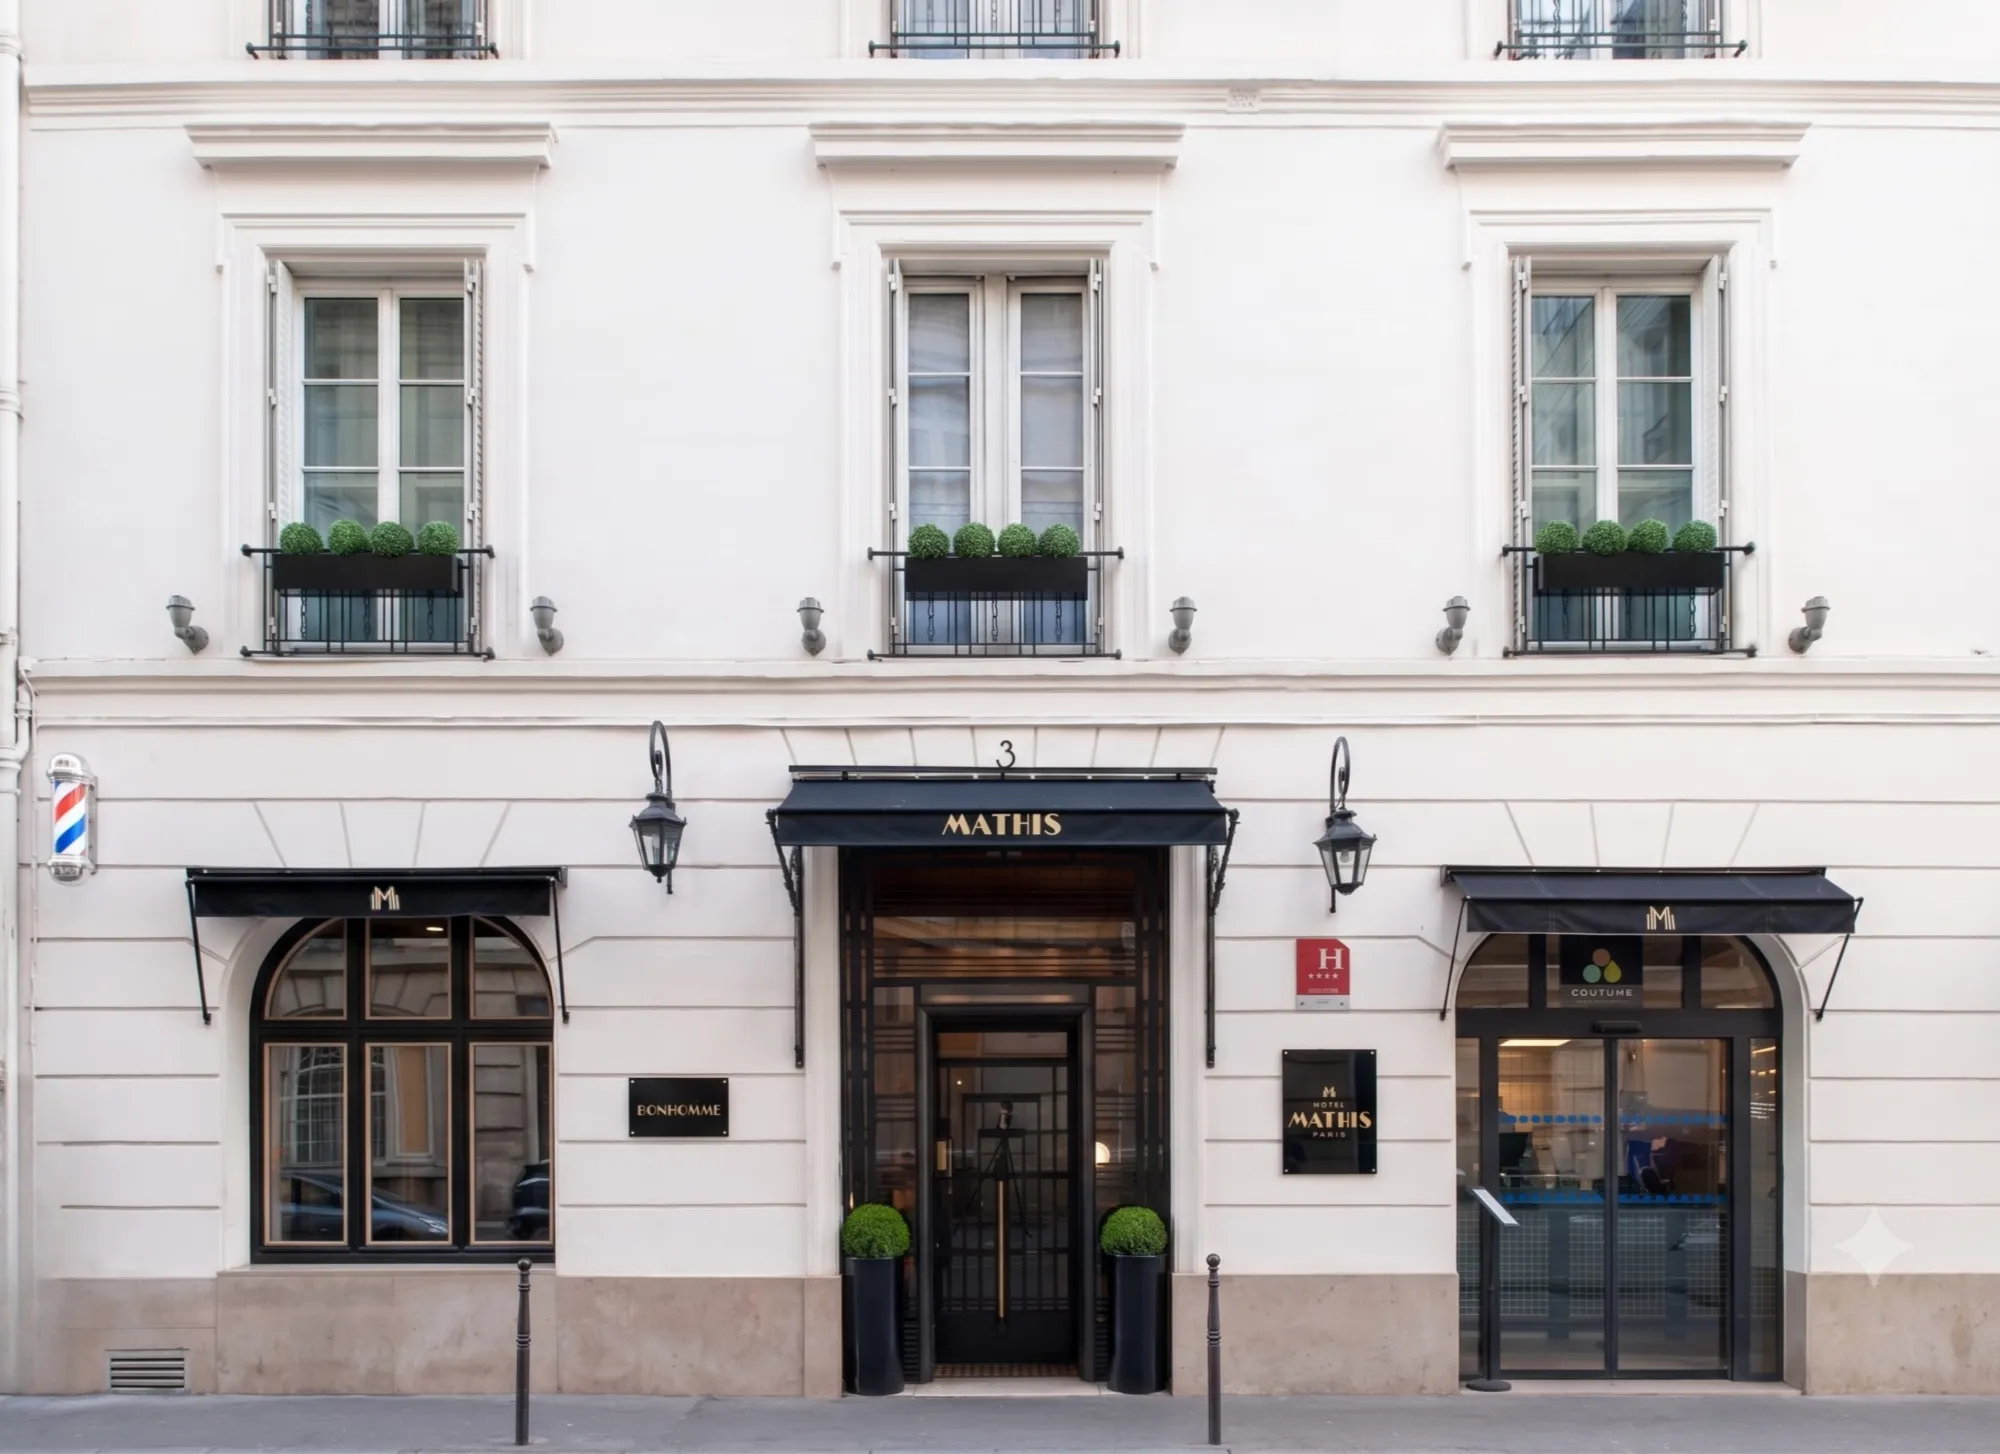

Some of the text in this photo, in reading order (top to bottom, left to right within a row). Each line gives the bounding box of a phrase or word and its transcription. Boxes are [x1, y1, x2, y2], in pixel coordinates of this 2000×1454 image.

[996, 740, 1016, 769] 3
[942, 813, 1062, 836] MATHIS
[1318, 948, 1344, 969] H
[1571, 988, 1633, 997] COUTUME
[637, 1104, 721, 1116] BONHOMME
[1287, 1111, 1372, 1128] MATHIS
